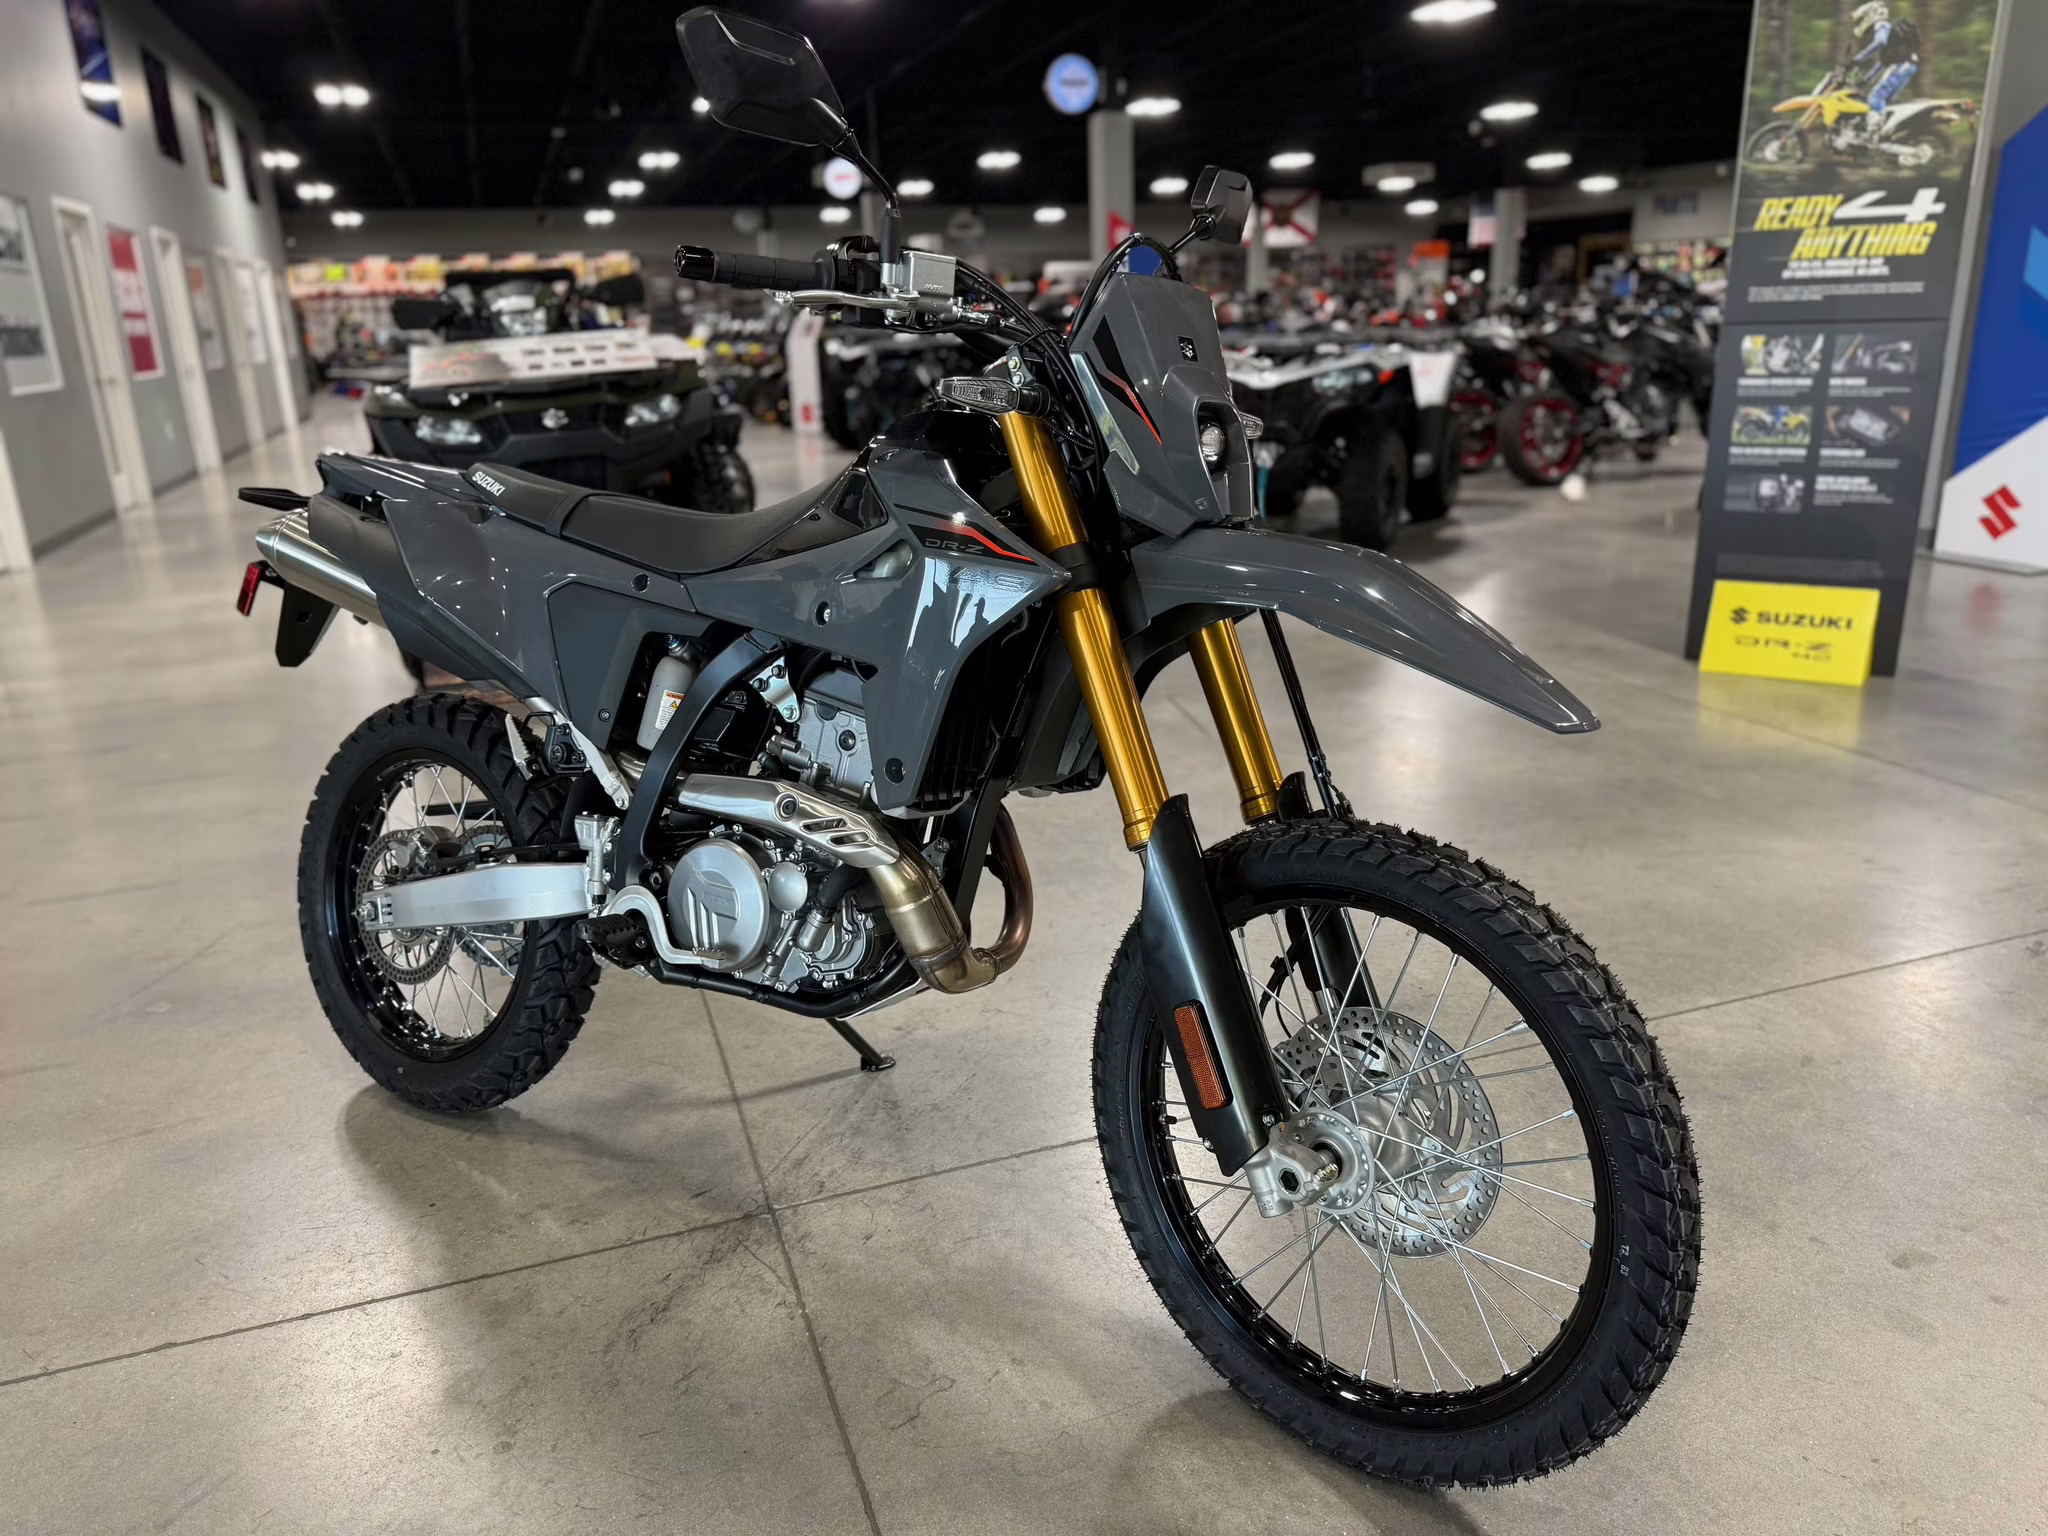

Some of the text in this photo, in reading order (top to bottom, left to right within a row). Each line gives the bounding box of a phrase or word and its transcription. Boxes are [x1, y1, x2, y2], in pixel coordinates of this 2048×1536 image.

[1753, 187, 1946, 231] READY 4
[1791, 221, 1938, 260] ANYTHING
[471, 471, 506, 497] SUZUKI
[925, 538, 985, 554] DR-Z
[1757, 611, 1853, 630] SUZUKI
